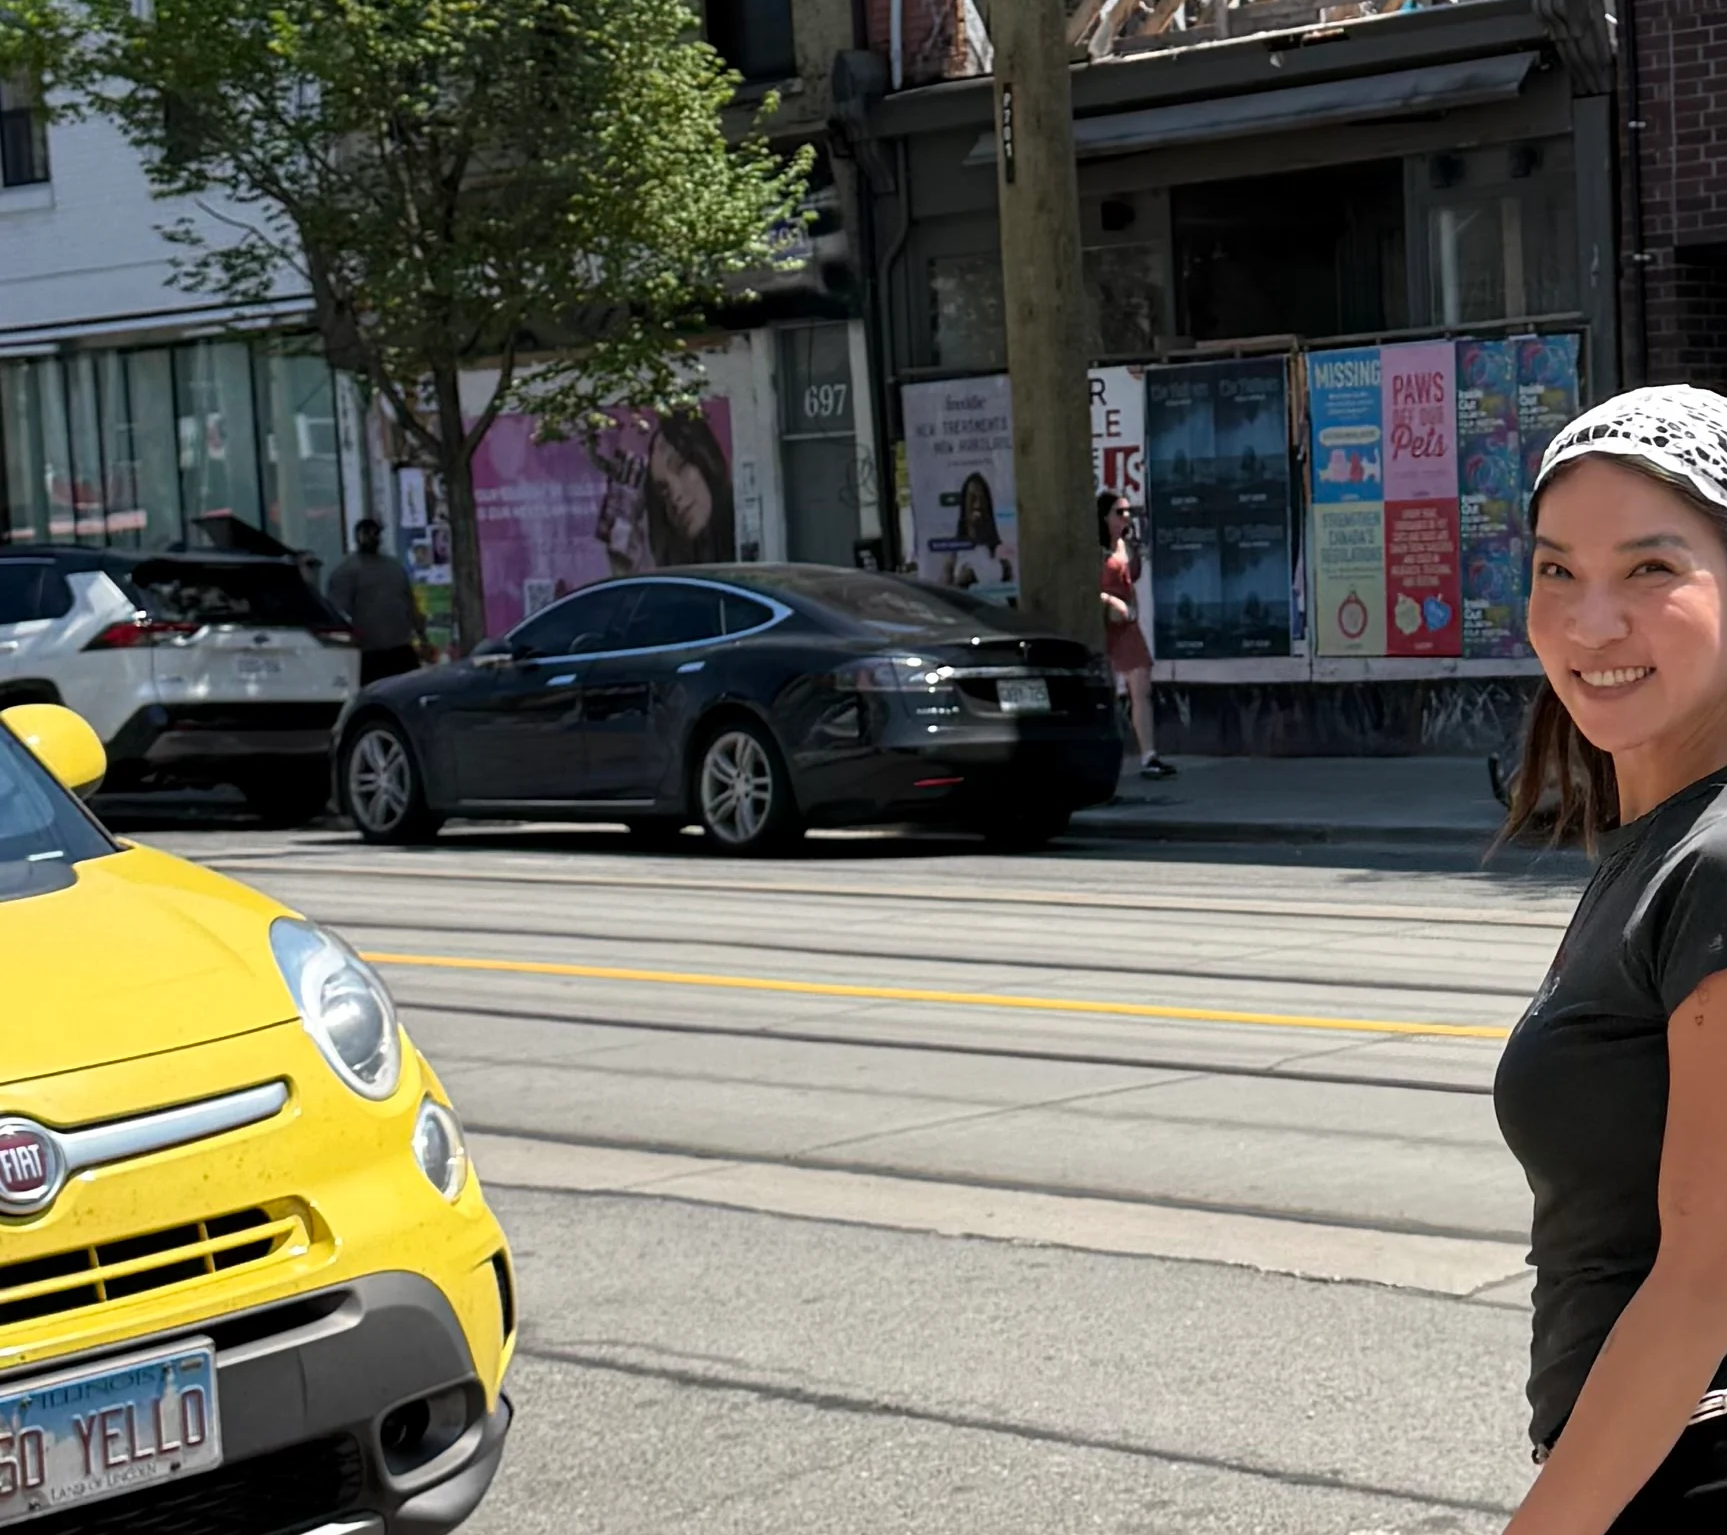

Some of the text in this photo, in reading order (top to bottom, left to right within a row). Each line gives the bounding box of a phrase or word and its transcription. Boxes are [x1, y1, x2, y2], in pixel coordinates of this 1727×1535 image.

[1314, 359, 1381, 388] MISSING
[1392, 372, 1444, 406] PAWS
[804, 384, 848, 417] 697
[1391, 423, 1447, 460] Pets
[0, 1144, 43, 1183] FIAT
[42, 1368, 155, 1410] ILLINOIS
[72, 1384, 207, 1476] YELLO
